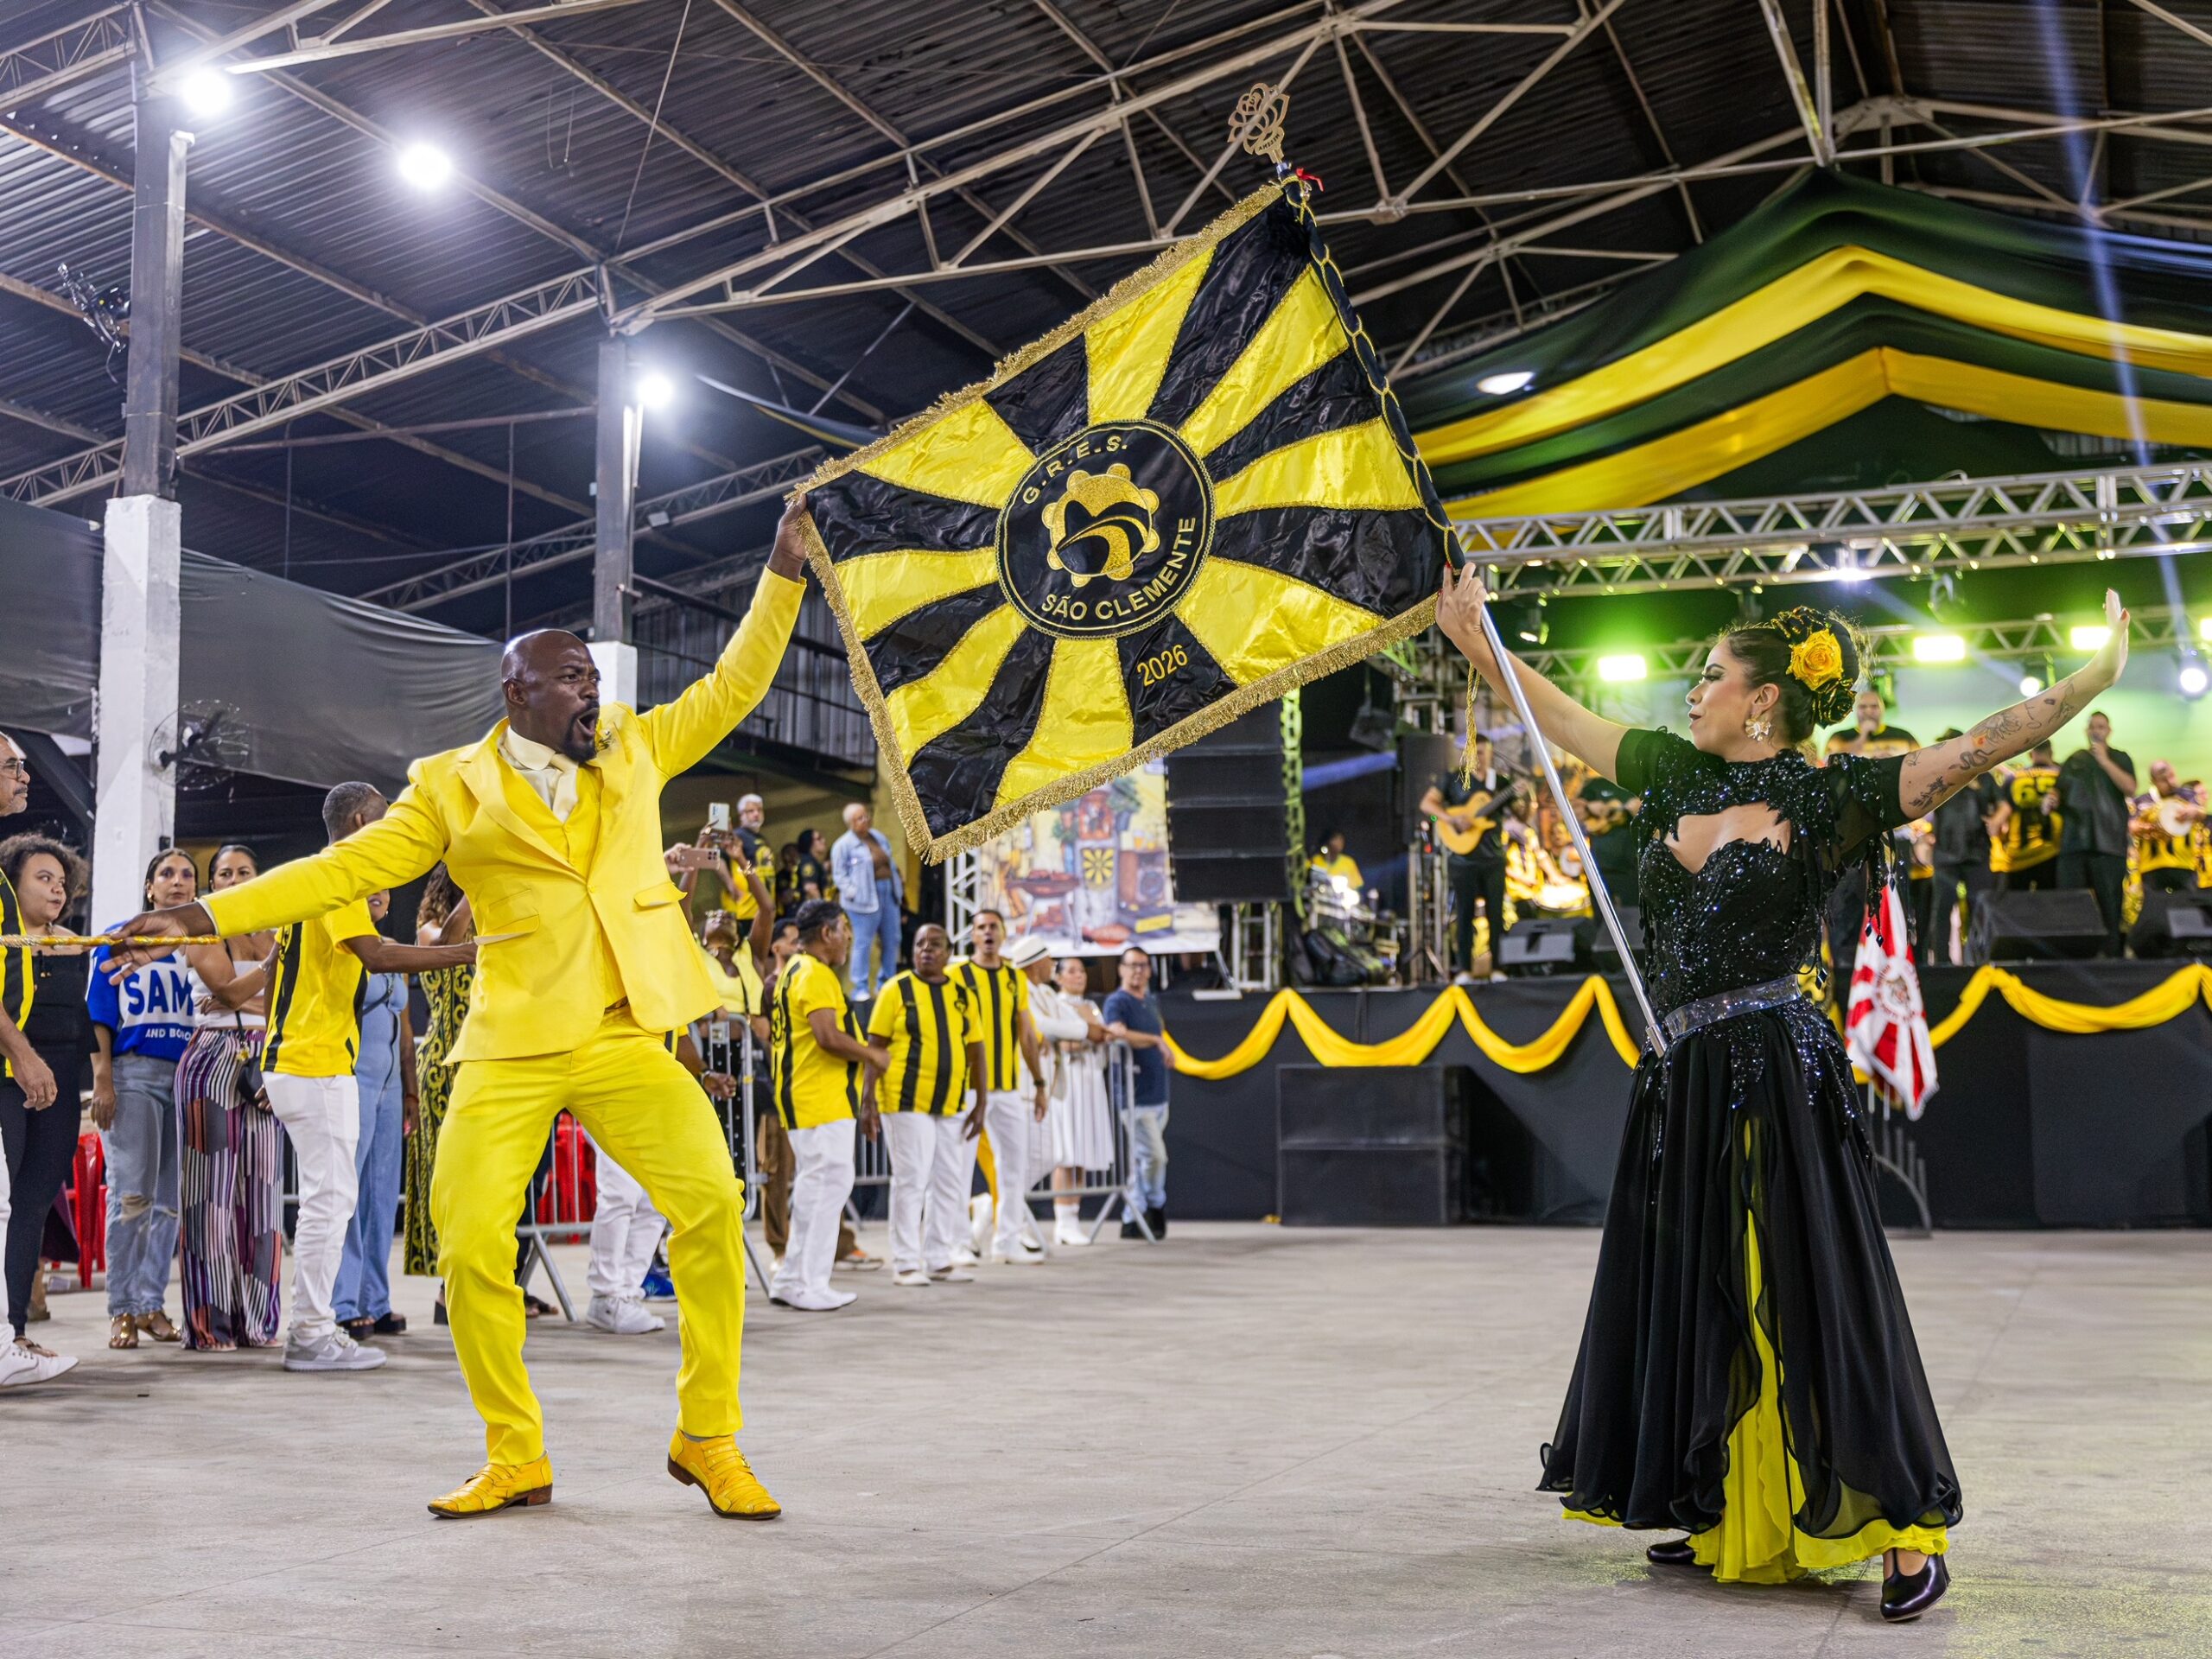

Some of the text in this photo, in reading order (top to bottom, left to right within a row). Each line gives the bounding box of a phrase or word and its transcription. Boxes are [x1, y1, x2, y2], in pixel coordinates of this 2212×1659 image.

[1022, 435, 1128, 504] G.R.E.S.
[1041, 518, 1196, 620] SÃO CLEMENTE
[1136, 644, 1188, 686] 2026
[124, 969, 194, 1016] SAM
[145, 1027, 166, 1039] AND
